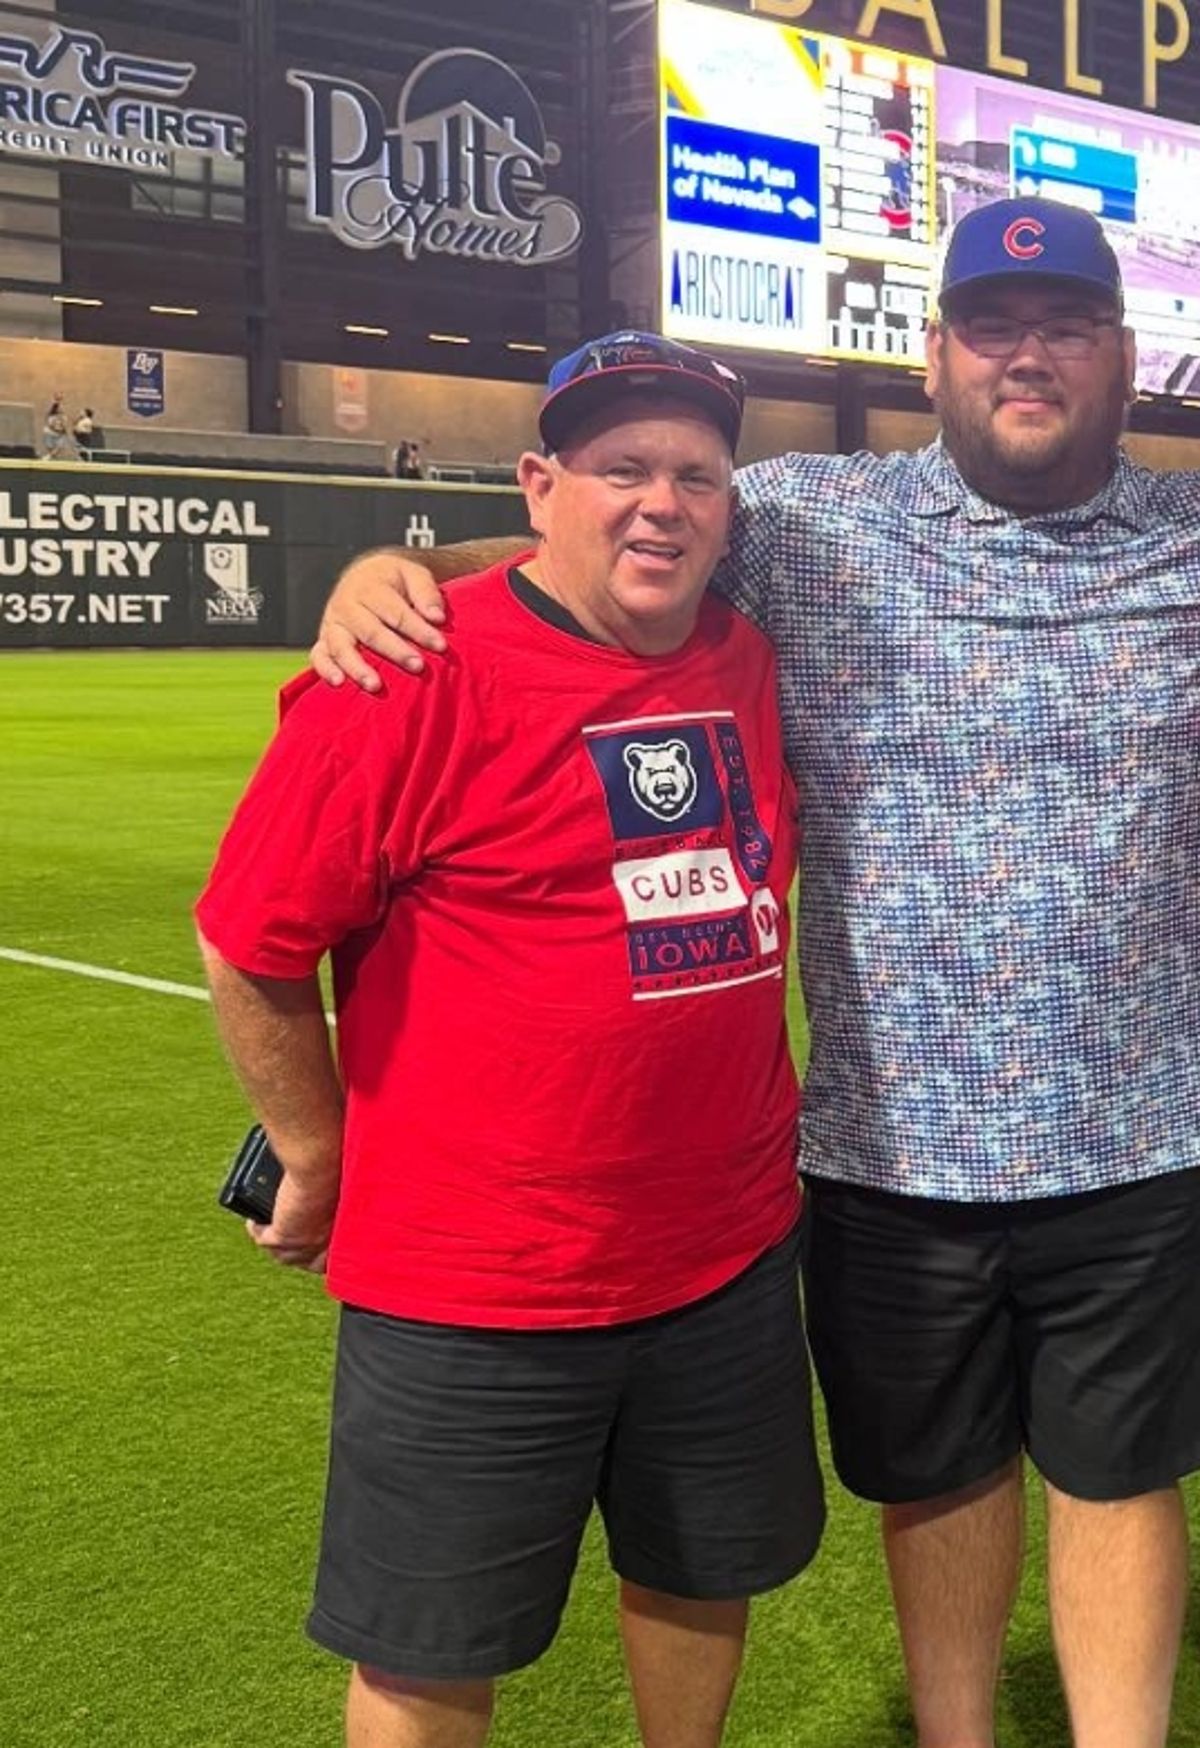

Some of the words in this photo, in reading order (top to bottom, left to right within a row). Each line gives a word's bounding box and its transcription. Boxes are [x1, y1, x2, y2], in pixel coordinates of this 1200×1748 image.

[0, 83, 107, 135] RICA
[113, 103, 246, 155] FIRST
[85, 142, 169, 169] UNION
[288, 70, 546, 220] Pulte
[748, 158, 796, 189] Plan
[345, 183, 582, 262] Homes
[1003, 217, 1046, 260] C
[671, 249, 804, 330] ARISTOCRAT
[0, 491, 270, 536] LECTRICAL
[0, 538, 161, 577] USTRY
[0, 594, 170, 624] 357.NET
[630, 865, 730, 902] CUBS
[637, 932, 746, 971] IOWA
